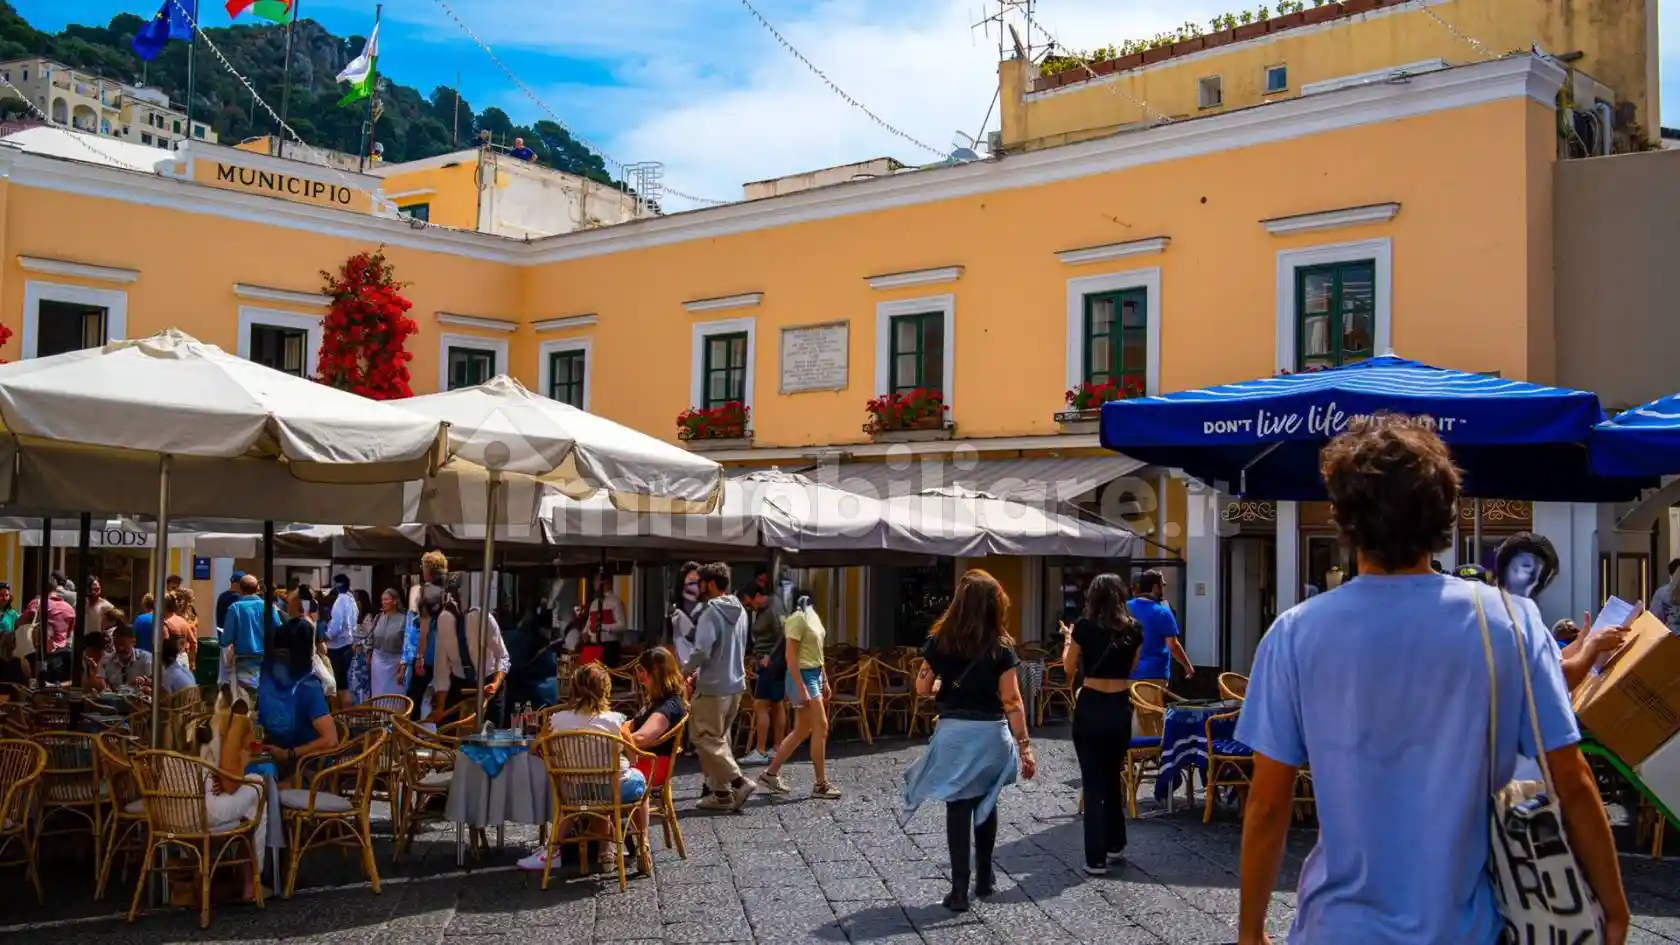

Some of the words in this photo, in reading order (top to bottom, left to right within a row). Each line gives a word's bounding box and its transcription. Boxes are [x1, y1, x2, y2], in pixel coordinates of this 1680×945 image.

[216, 162, 352, 205] MUNICIPIO
[1203, 419, 1253, 434] DON'T
[1256, 409, 1304, 438] live
[1308, 401, 1349, 437] life
